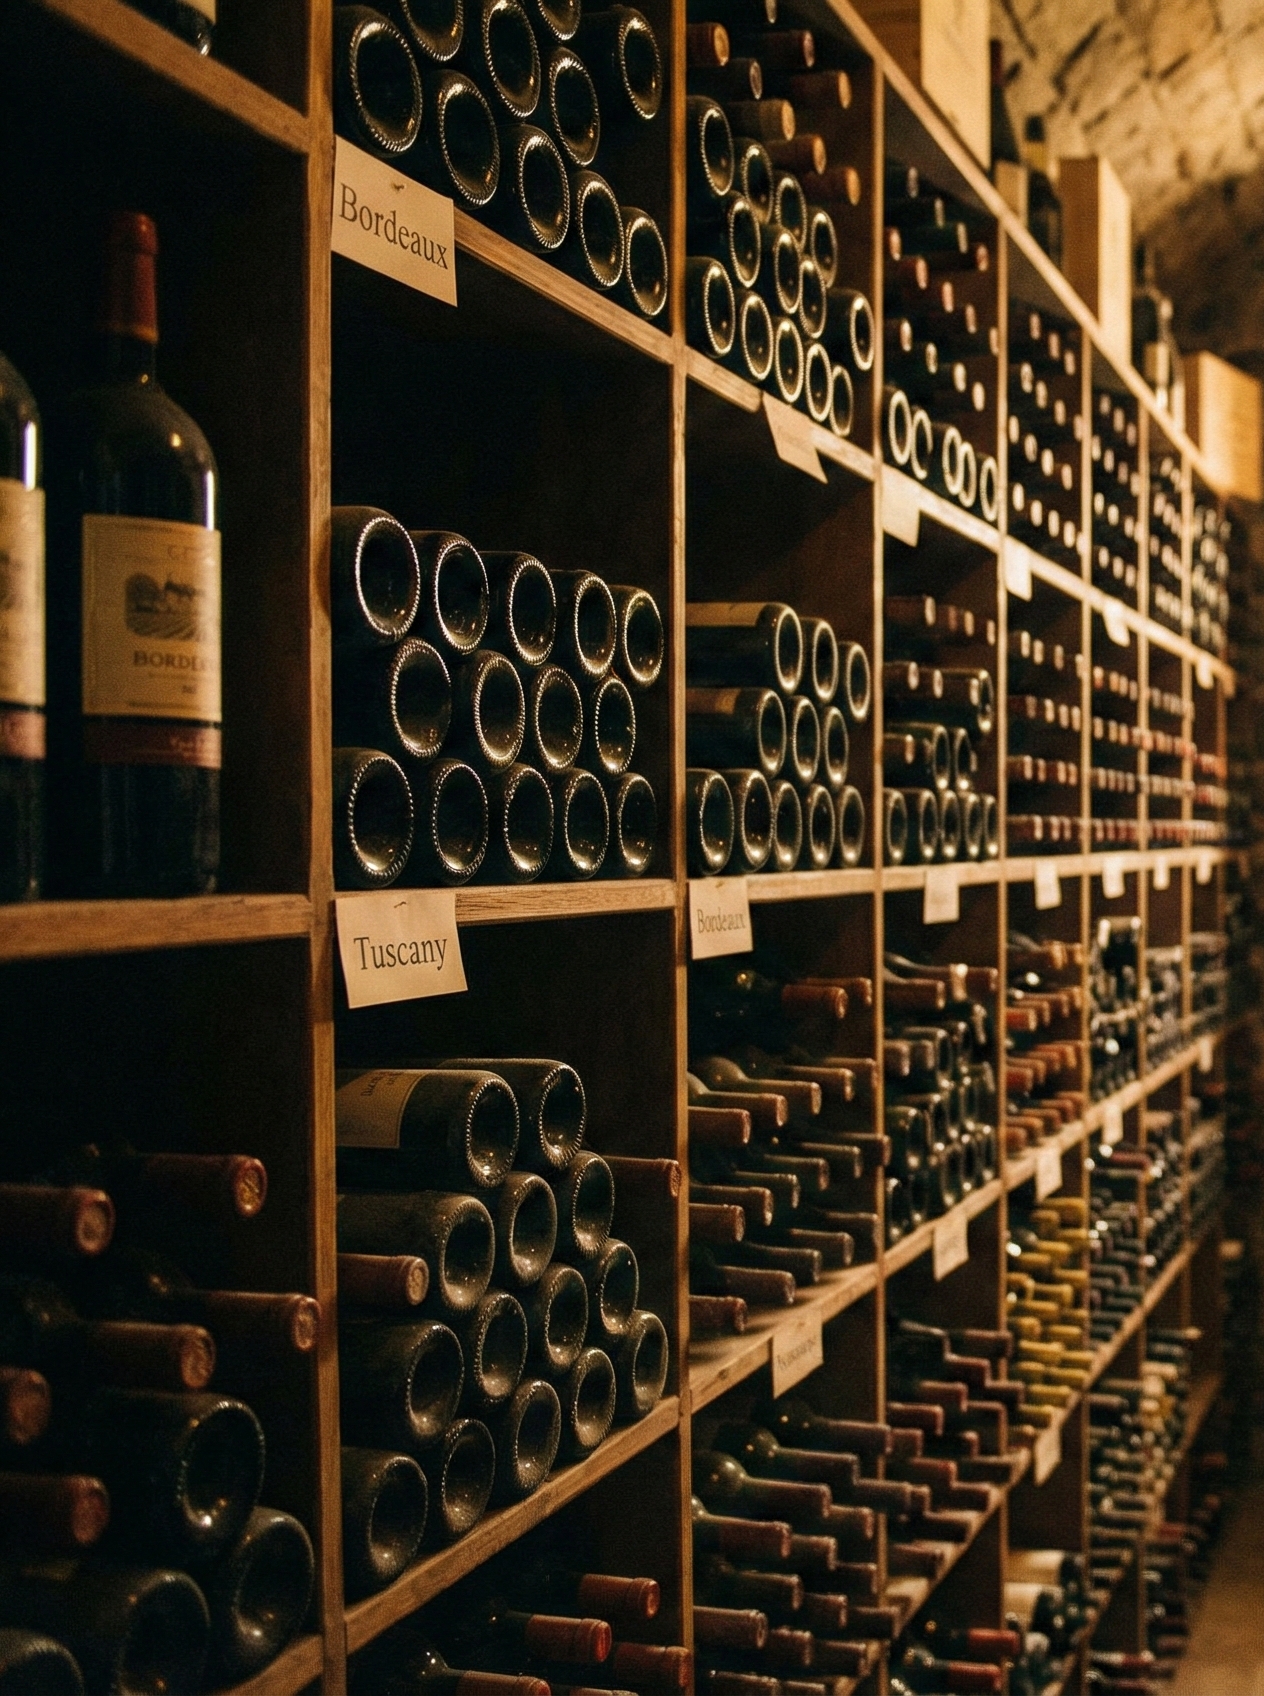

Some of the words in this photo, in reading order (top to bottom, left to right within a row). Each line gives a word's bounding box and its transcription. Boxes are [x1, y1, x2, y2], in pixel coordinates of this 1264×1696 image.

[339, 183, 448, 270] Bordeaux
[696, 907, 746, 934] Bordeaux
[353, 936, 448, 972] Tuscany
